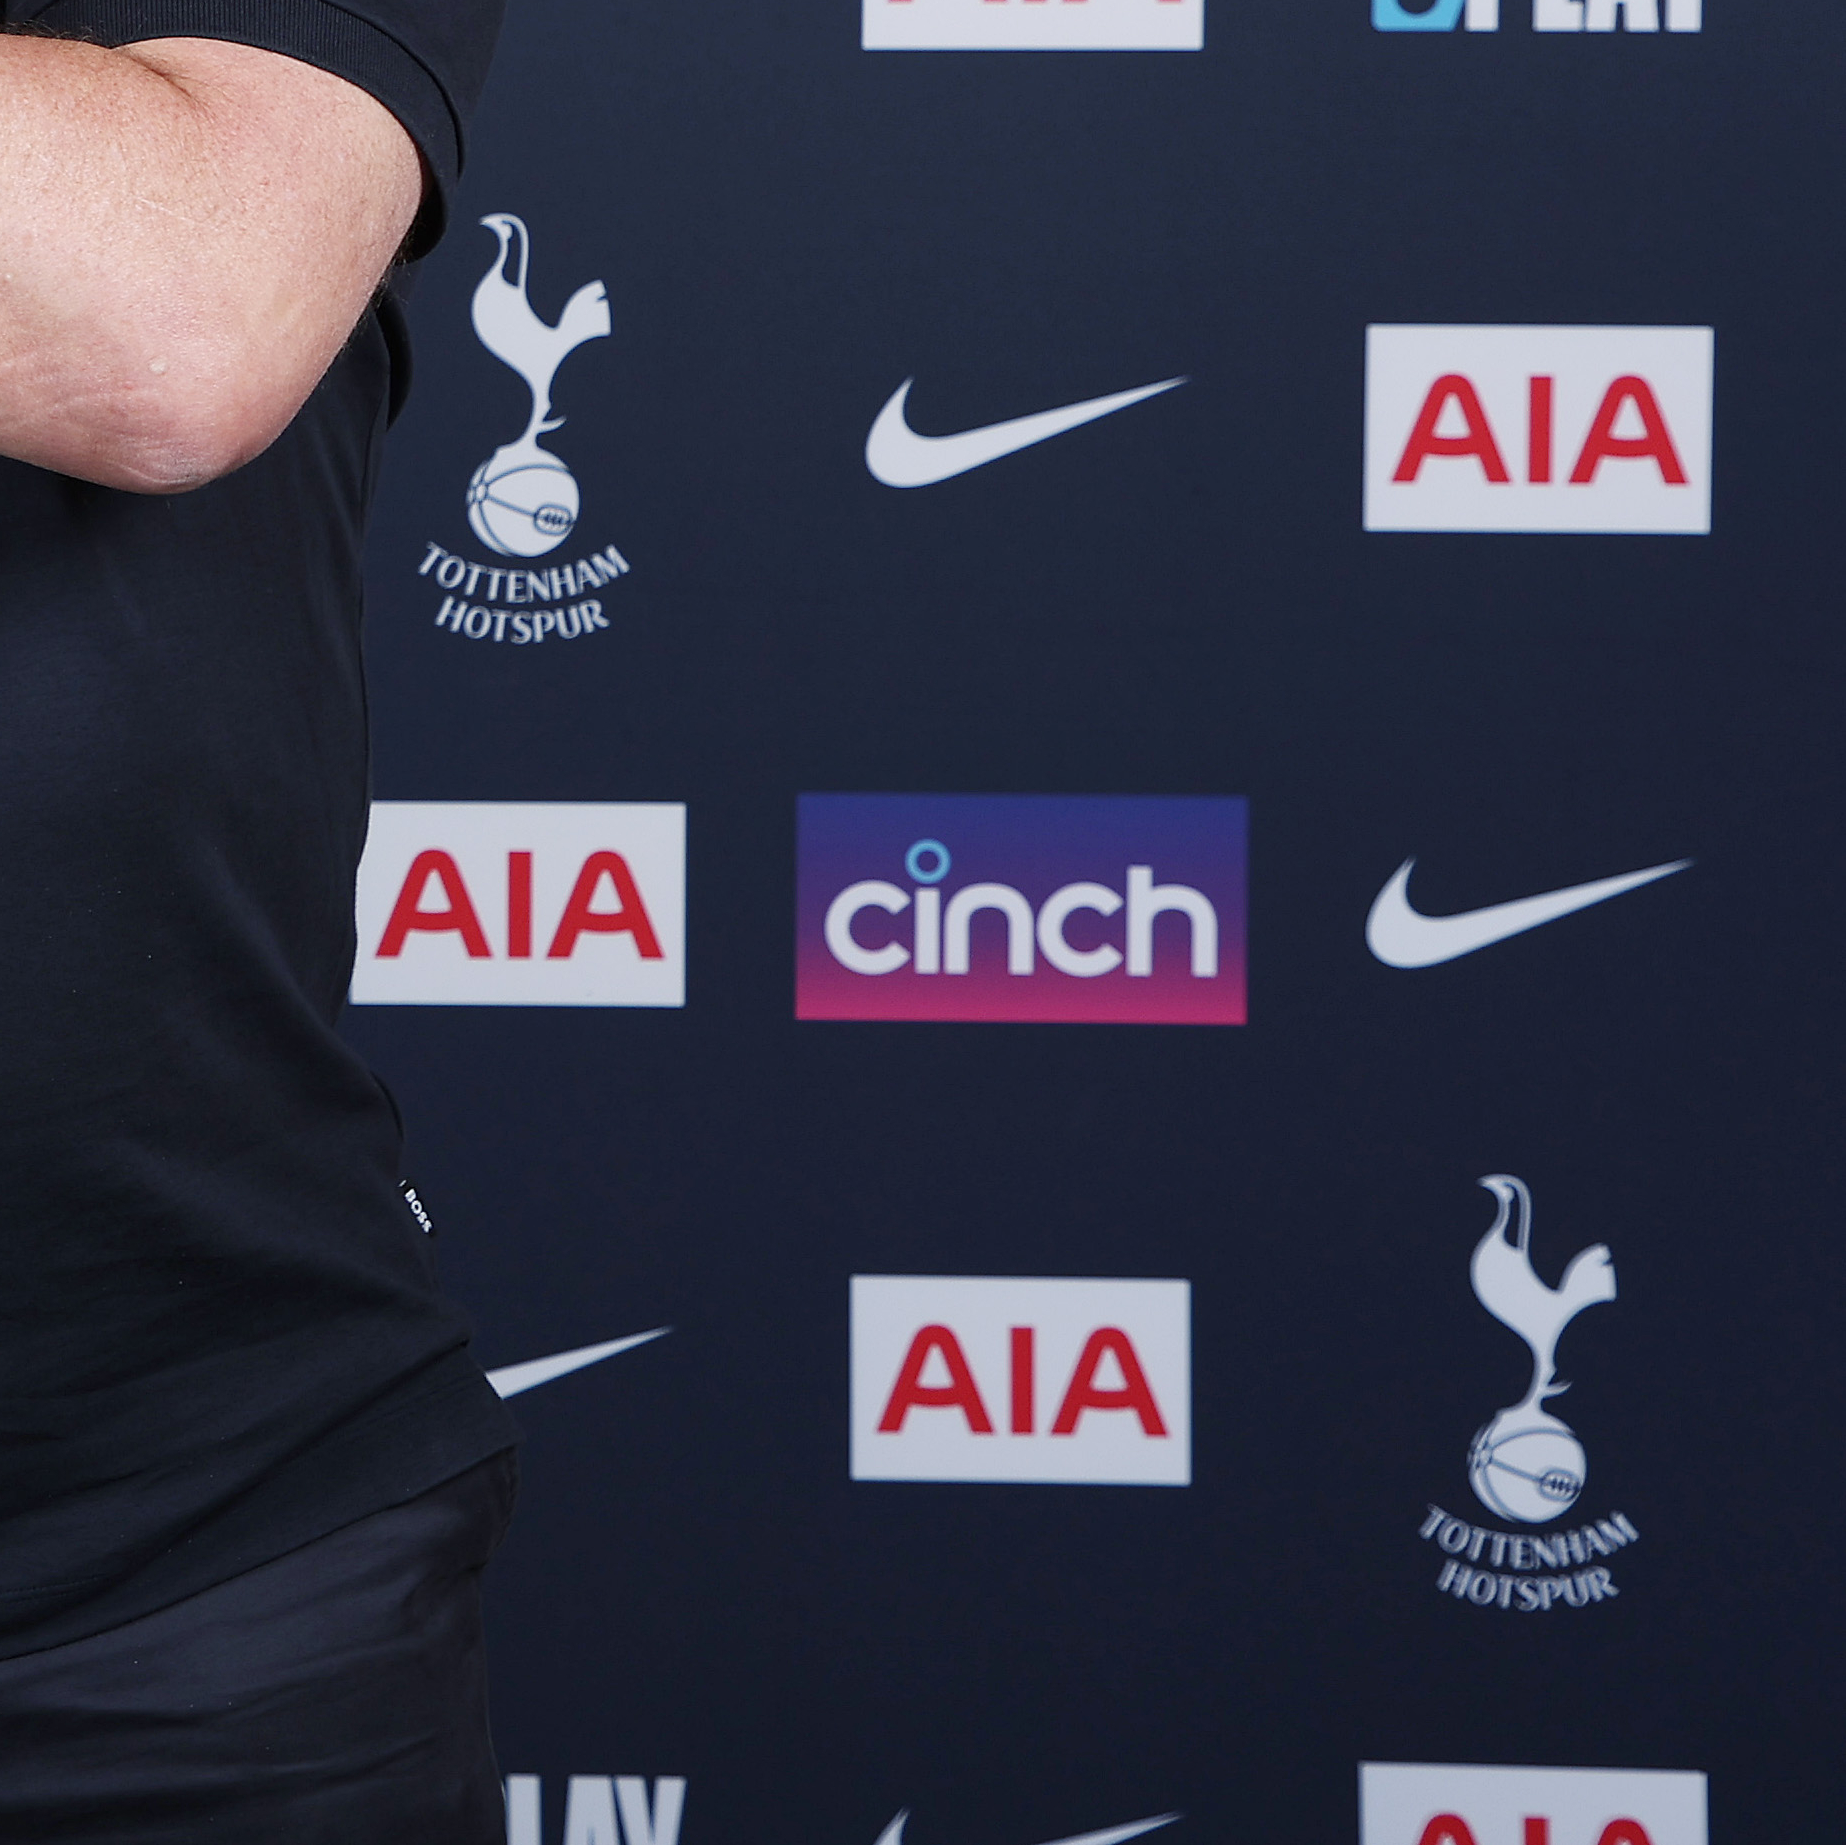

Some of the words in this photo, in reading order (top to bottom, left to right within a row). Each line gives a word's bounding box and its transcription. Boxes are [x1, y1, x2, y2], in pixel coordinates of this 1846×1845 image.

[1393, 374, 1688, 485] AIA
[418, 541, 630, 604] TOTTENHAM
[435, 595, 610, 644] HOTSPUR
[377, 849, 664, 960] AIA
[824, 840, 1218, 978] cinch
[404, 1188, 433, 1233] BOSS
[878, 1325, 1167, 1437] AIA
[1418, 1504, 1639, 1570] TOTTENHAM
[1437, 1561, 1620, 1612] HOTSPUR
